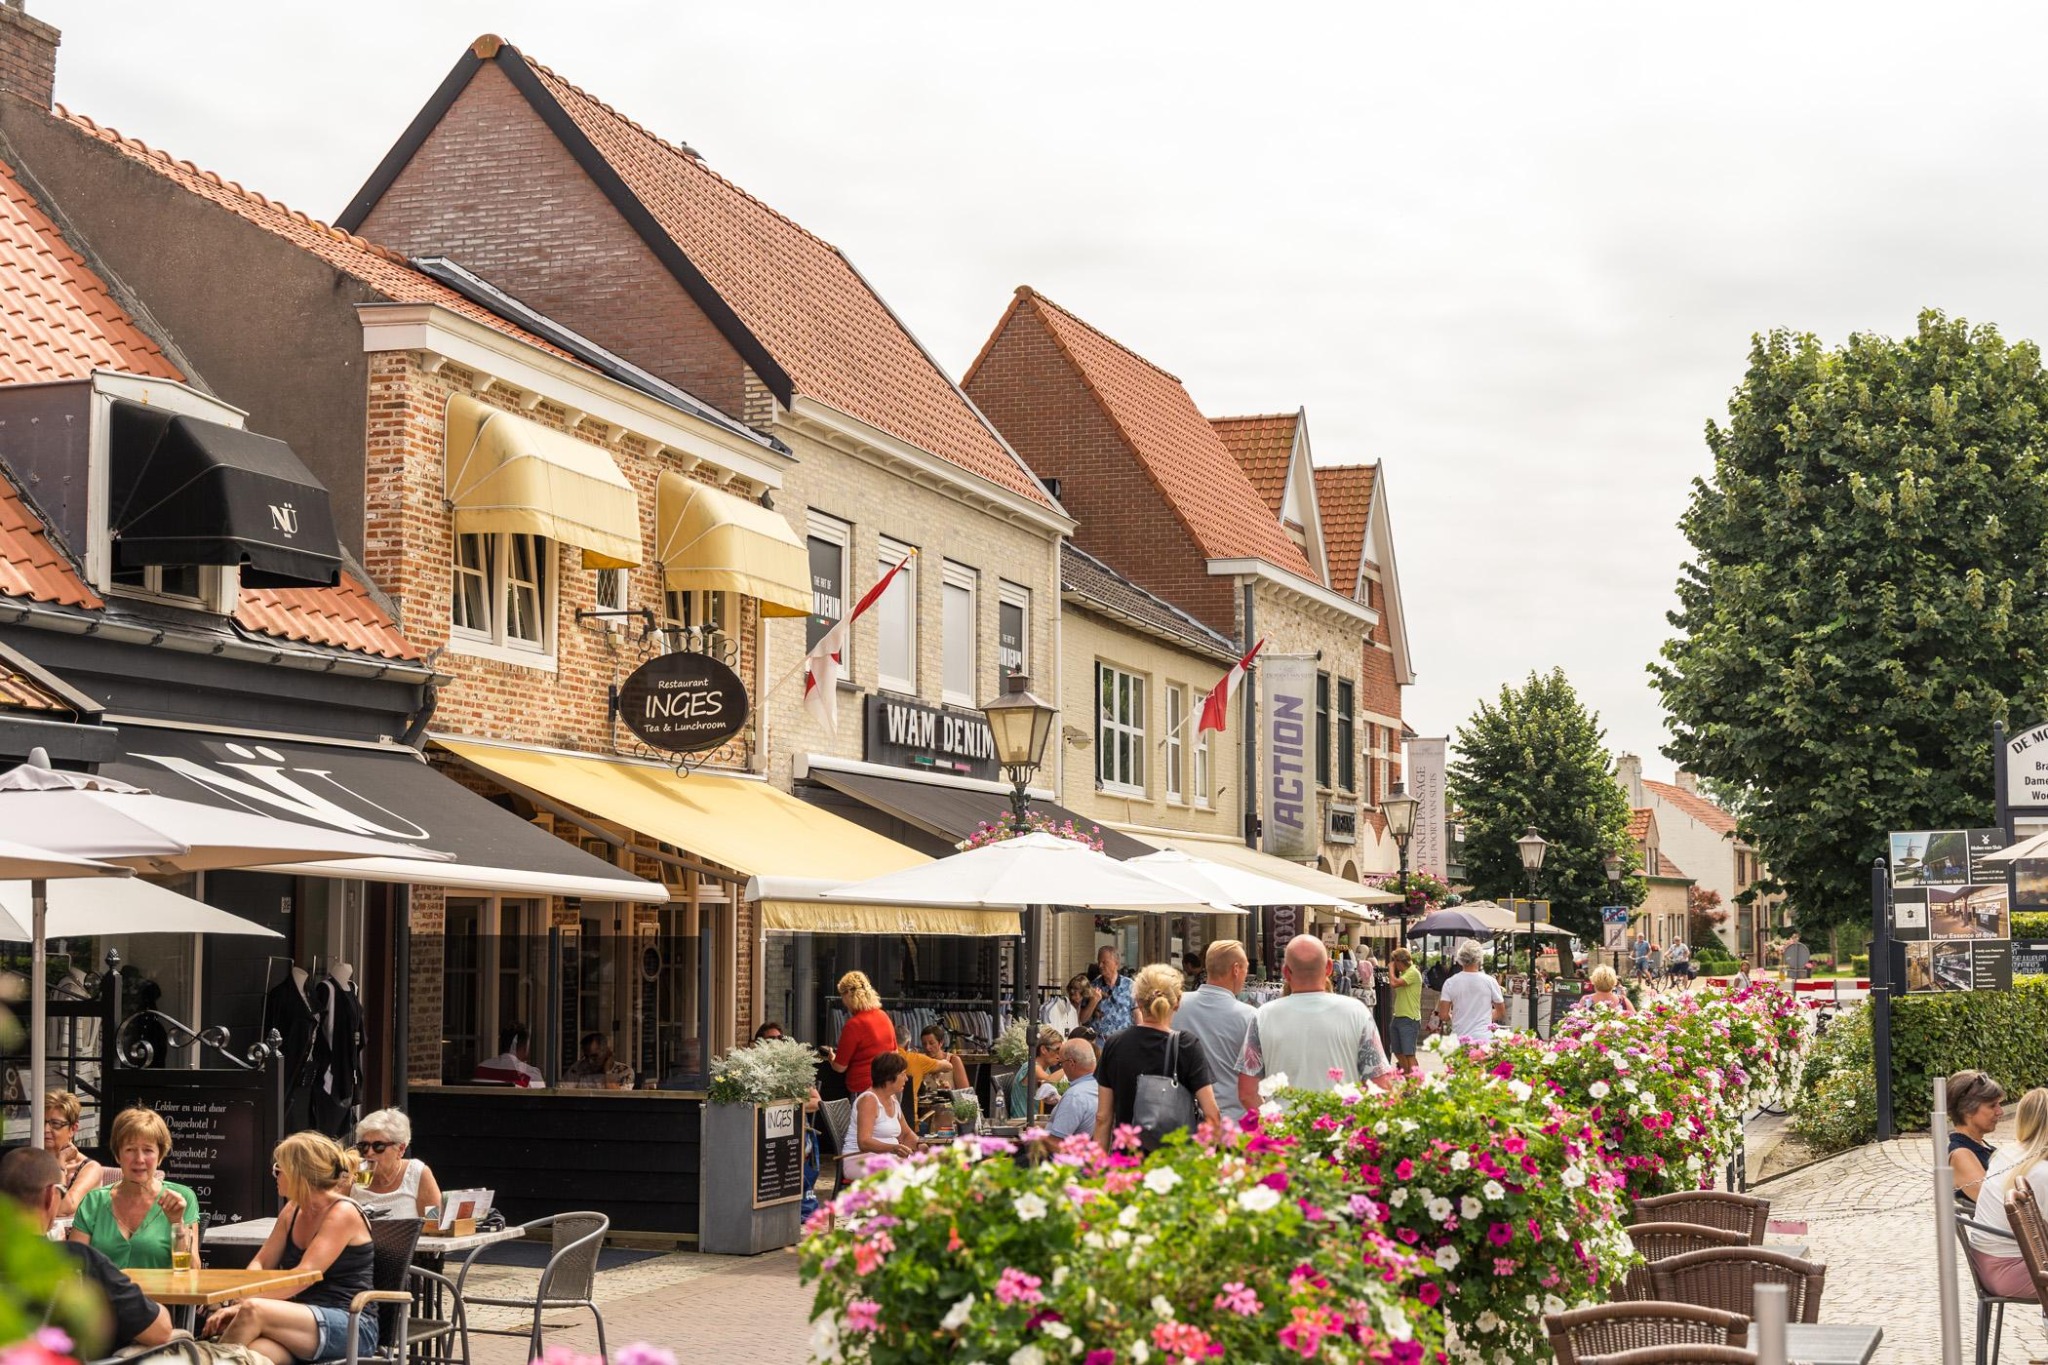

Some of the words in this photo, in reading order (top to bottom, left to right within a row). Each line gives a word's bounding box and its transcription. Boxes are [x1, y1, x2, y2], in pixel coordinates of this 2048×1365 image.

[820, 593, 841, 620] DENIM
[658, 677, 709, 689] Restaurant
[645, 690, 723, 719] INGES
[644, 724, 660, 733] Tea
[663, 723, 671, 732] &
[675, 720, 727, 731] Lunchroom
[886, 703, 936, 750] WAM
[943, 715, 995, 760] DENIM
[2011, 736, 2032, 755] DE
[1273, 693, 1304, 830] ACTION
[1429, 773, 1438, 799] SLUIS
[1429, 801, 1438, 819] VAN
[1429, 822, 1438, 851] POORT
[154, 1100, 180, 1111] Lekker
[193, 1103, 207, 1112] niet
[165, 1115, 209, 1130] Dagschotel
[768, 1108, 793, 1129] INGES
[210, 1149, 218, 1159] 2
[212, 1210, 227, 1223] dag
